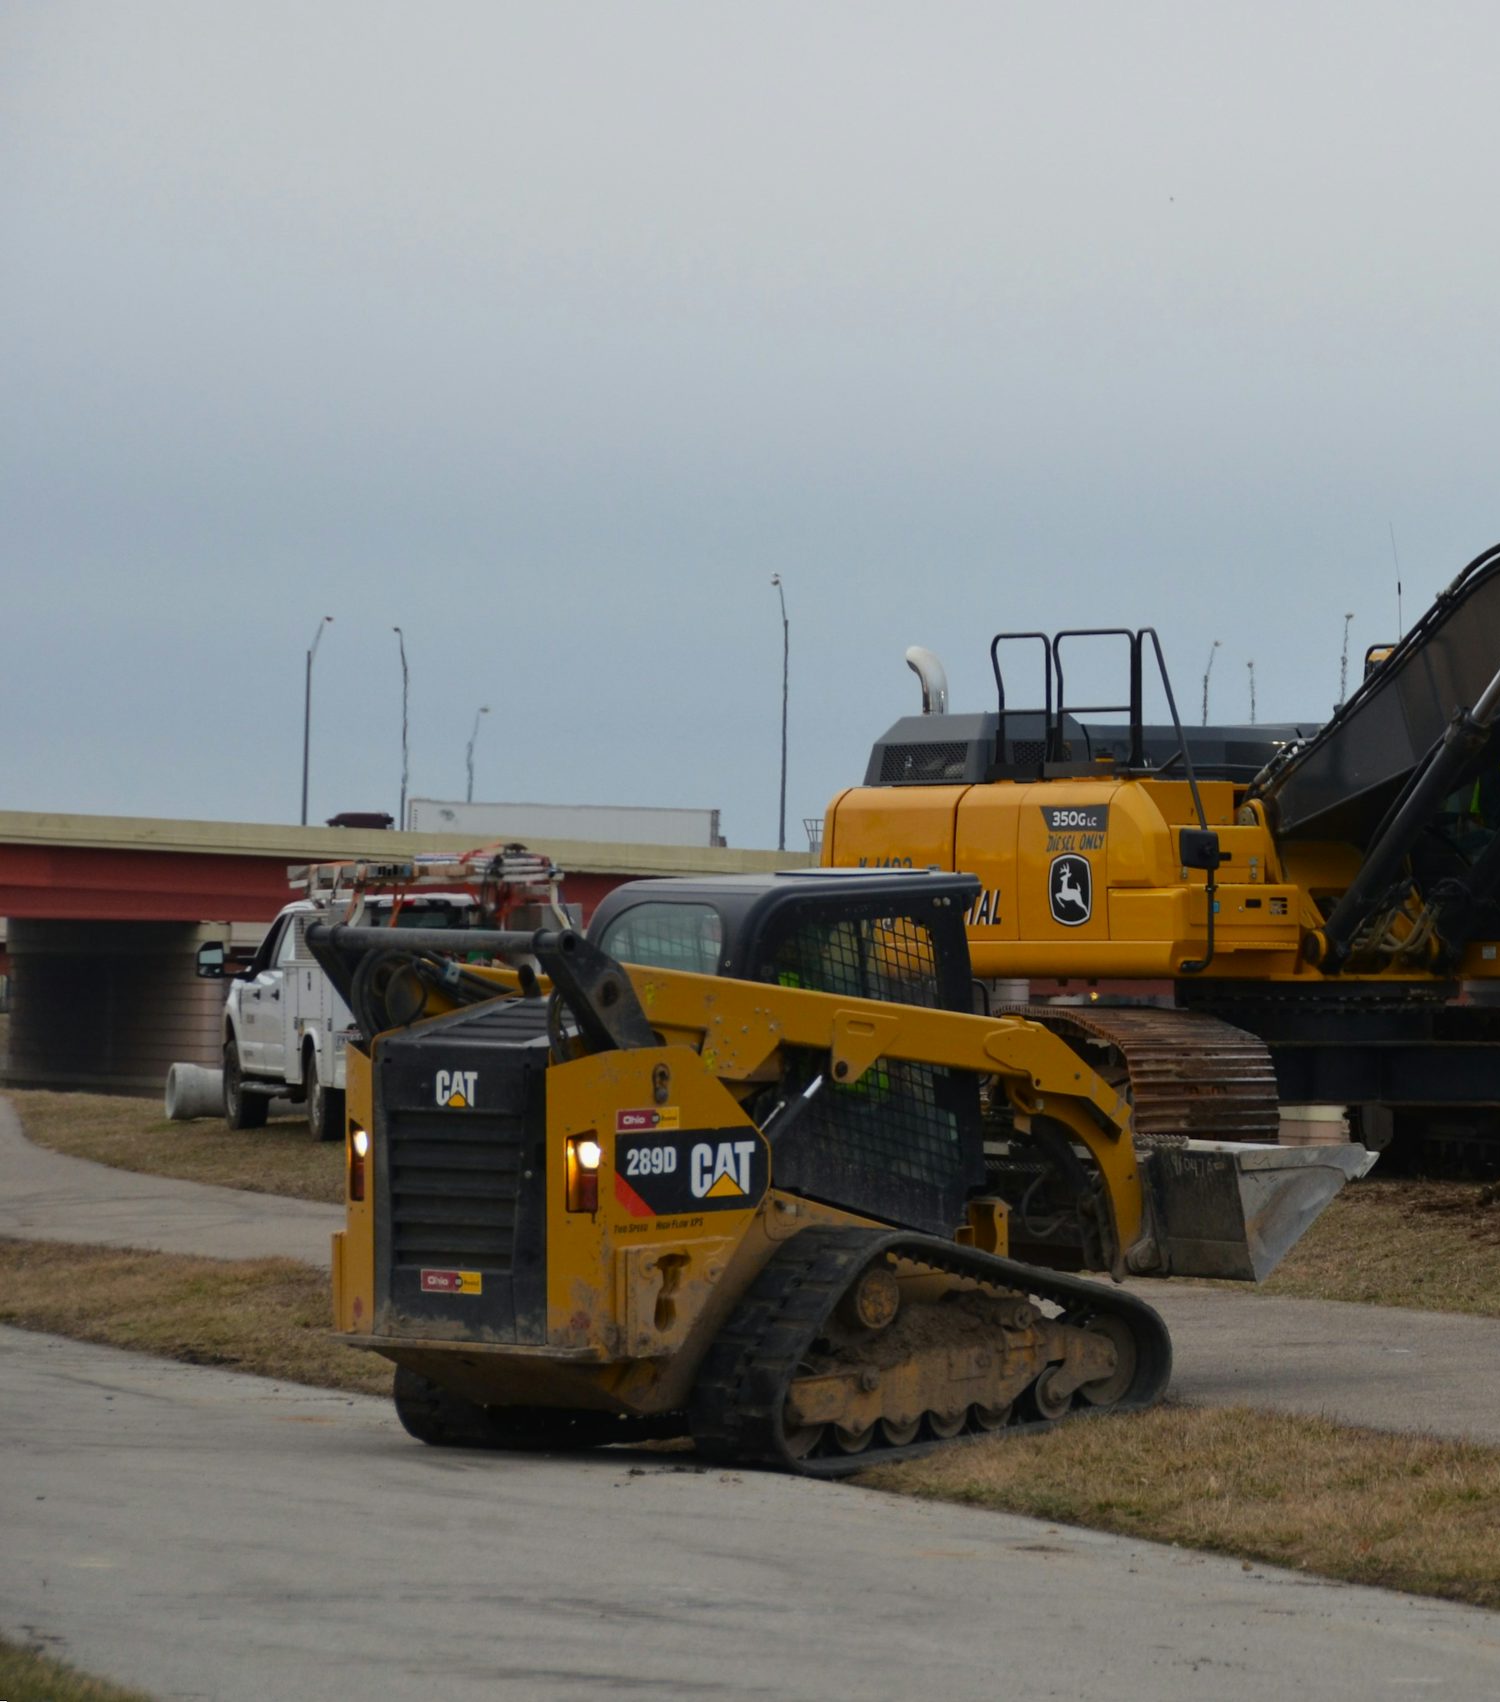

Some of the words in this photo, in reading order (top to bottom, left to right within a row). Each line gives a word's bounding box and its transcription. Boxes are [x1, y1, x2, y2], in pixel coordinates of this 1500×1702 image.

[1080, 833, 1105, 851] ONLY
[435, 1069, 478, 1107] CAT
[626, 1146, 677, 1176] 289D
[690, 1141, 756, 1198] CAT
